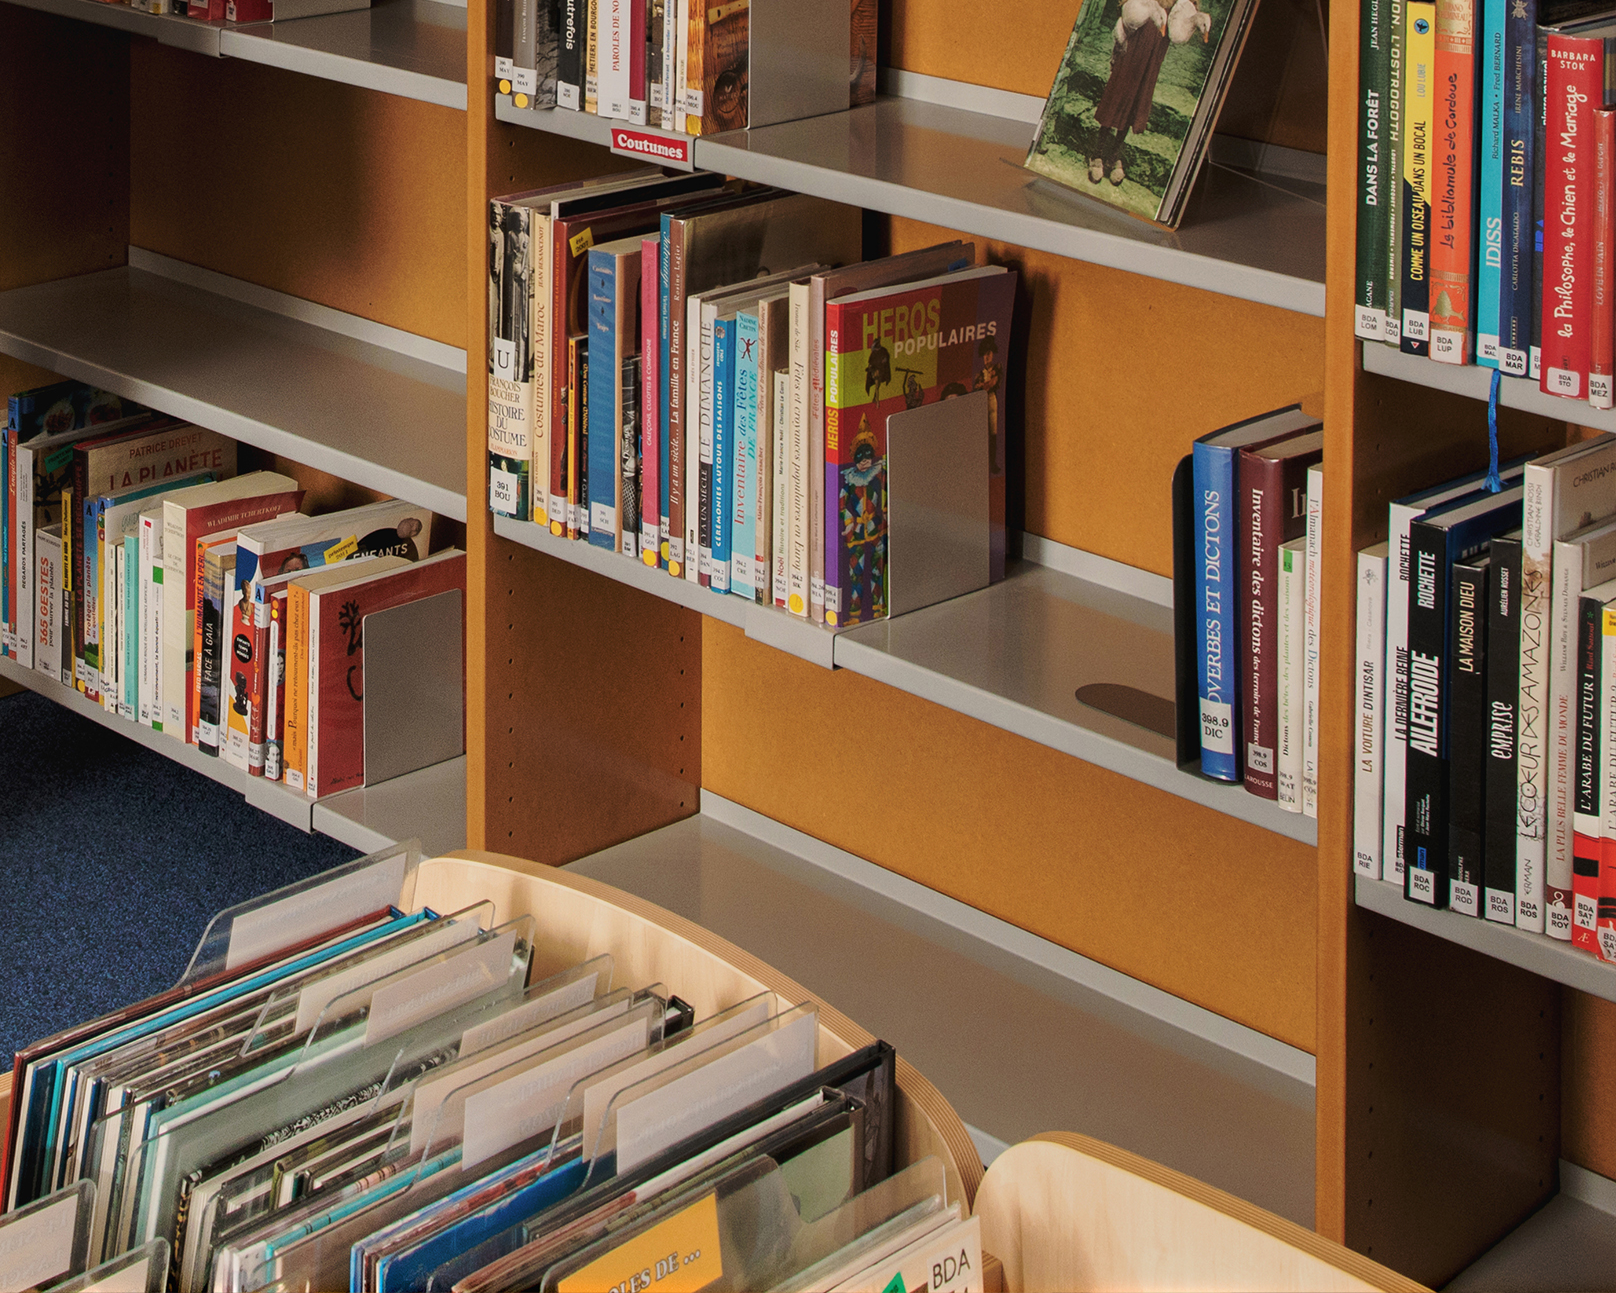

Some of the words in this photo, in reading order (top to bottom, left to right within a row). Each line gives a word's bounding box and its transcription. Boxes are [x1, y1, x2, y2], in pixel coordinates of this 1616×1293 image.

[1551, 49, 1596, 62] BARBARA
[1560, 61, 1586, 71] STOK
[1366, 89, 1379, 139] FORÊT
[618, 134, 684, 160] Coutumes
[1366, 143, 1379, 161] LA
[1510, 140, 1524, 186] REBIS
[1366, 165, 1379, 205] DANS
[1486, 217, 1501, 267] IDISS
[862, 298, 940, 349] HEROS
[894, 322, 997, 358] POPULAIRES
[1409, 328, 1424, 336] LUB
[830, 329, 839, 402] POPULAIRES
[1505, 361, 1523, 370] MAR
[1506, 353, 1523, 362] BDA
[828, 407, 838, 451] HEROS
[1204, 490, 1221, 582] DICTONS
[39, 557, 50, 615] GESTES
[1417, 551, 1435, 609] ROCHETTE
[1206, 586, 1220, 613] ET
[39, 618, 50, 644] 365
[204, 623, 214, 644] GAÏA
[204, 657, 214, 681] FACE
[1201, 712, 1228, 727] 398.9
[1410, 652, 1439, 757] AILEFROIDE
[1581, 686, 1594, 727] FUTUR
[1205, 726, 1223, 739] DIC
[1581, 732, 1594, 752] DU
[1580, 756, 1595, 811] L'ARABE
[932, 1249, 971, 1290] BDA
